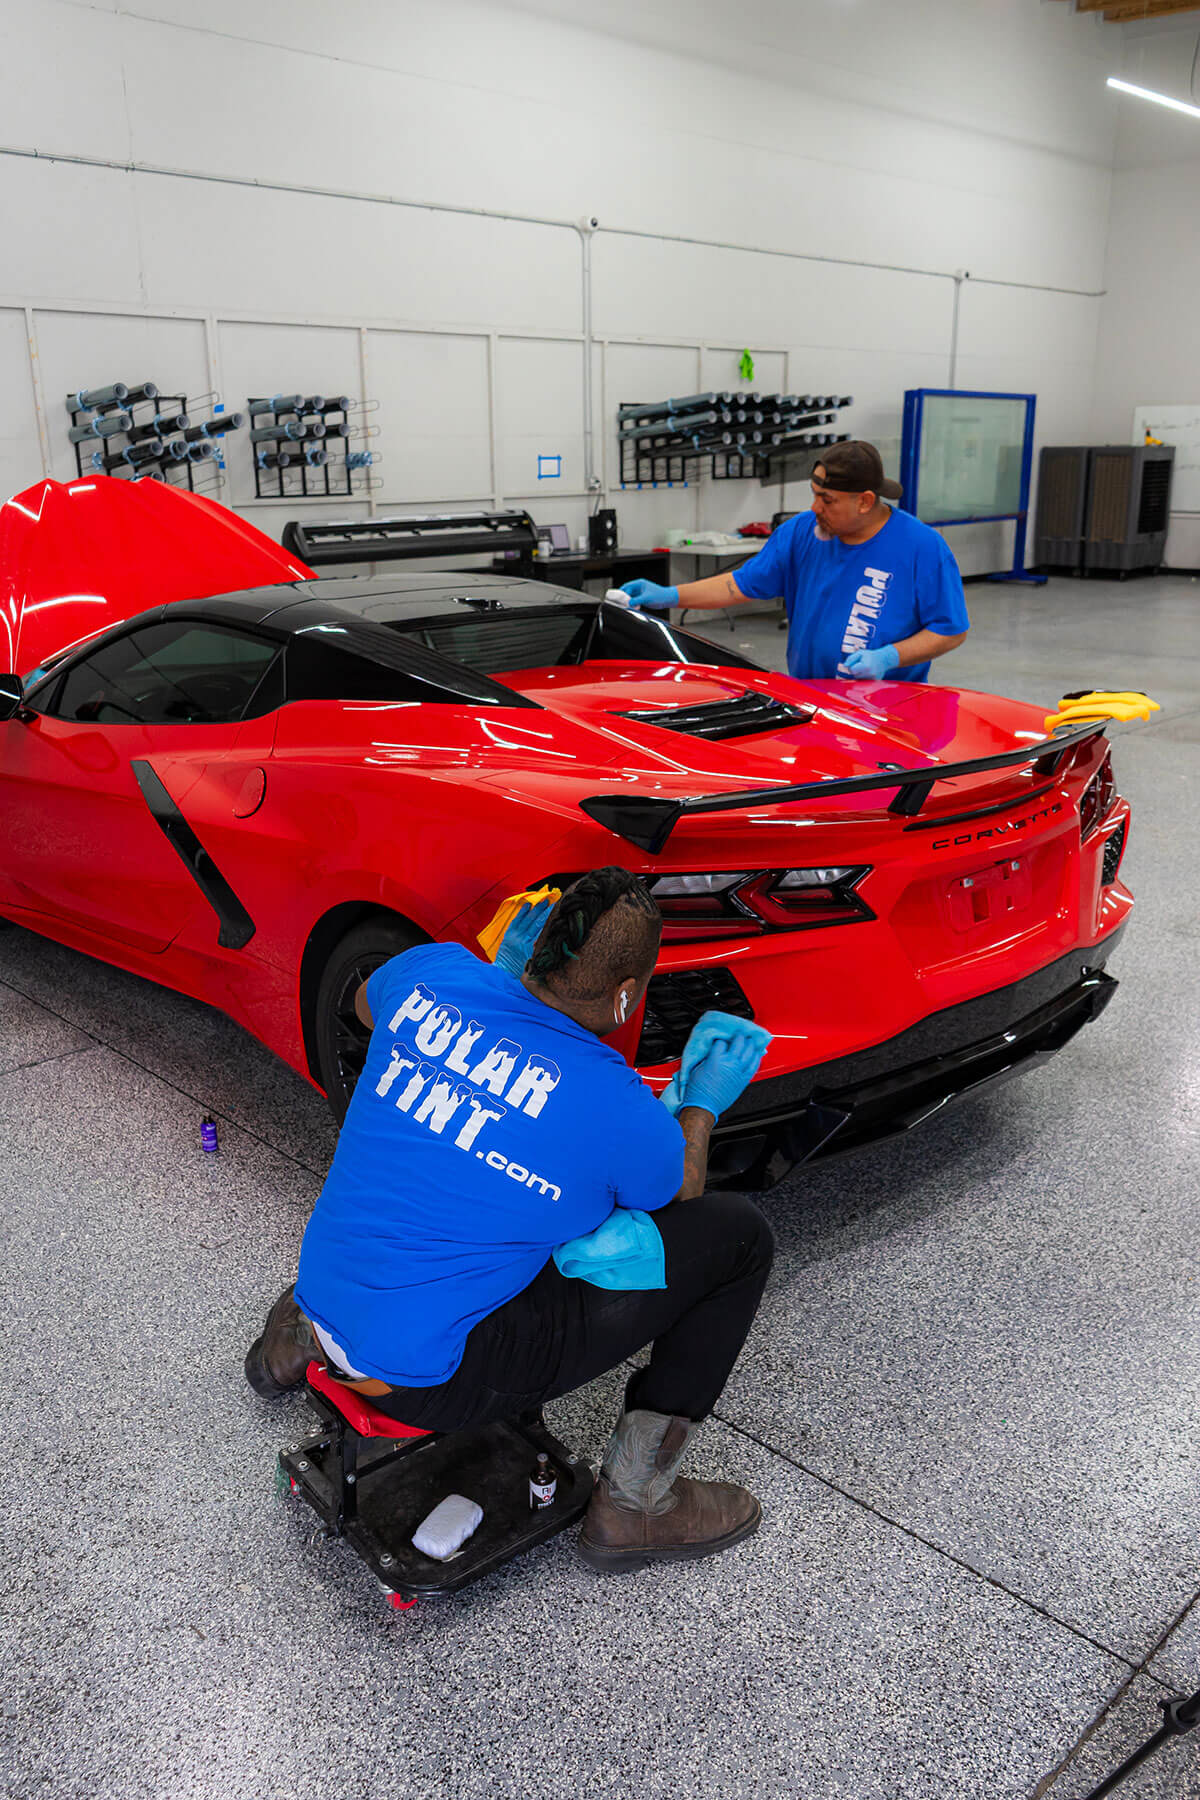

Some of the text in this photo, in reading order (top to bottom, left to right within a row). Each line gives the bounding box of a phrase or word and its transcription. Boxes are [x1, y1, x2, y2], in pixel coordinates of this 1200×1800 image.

[841, 567, 893, 653] POLAR
[932, 803, 1062, 850] CORVETTE
[388, 983, 562, 1119] POLAR
